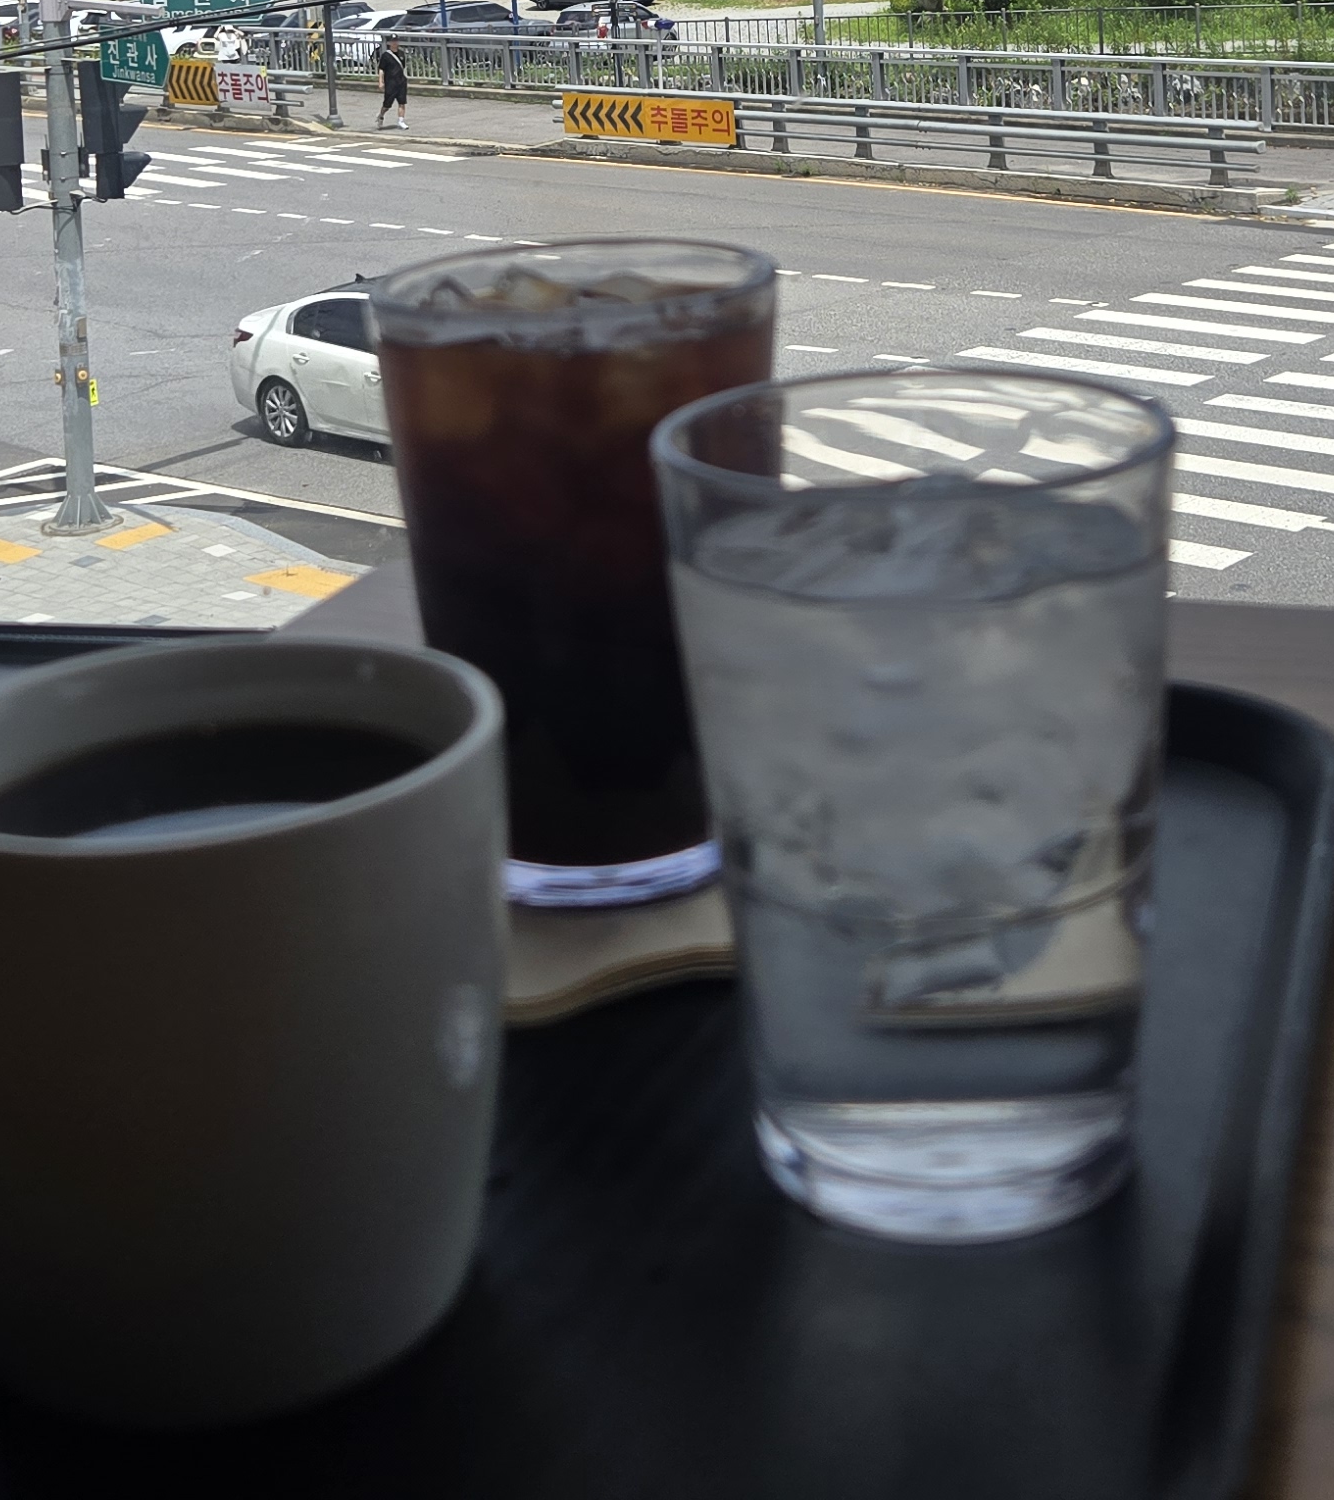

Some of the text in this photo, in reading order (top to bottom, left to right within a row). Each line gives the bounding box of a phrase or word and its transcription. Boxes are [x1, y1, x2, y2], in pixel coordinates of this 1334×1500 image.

[107, 39, 158, 71] 진관사
[112, 65, 156, 83] Jinkwansa
[218, 71, 270, 103] 추돌주의
[650, 105, 731, 137] 추돌주의
